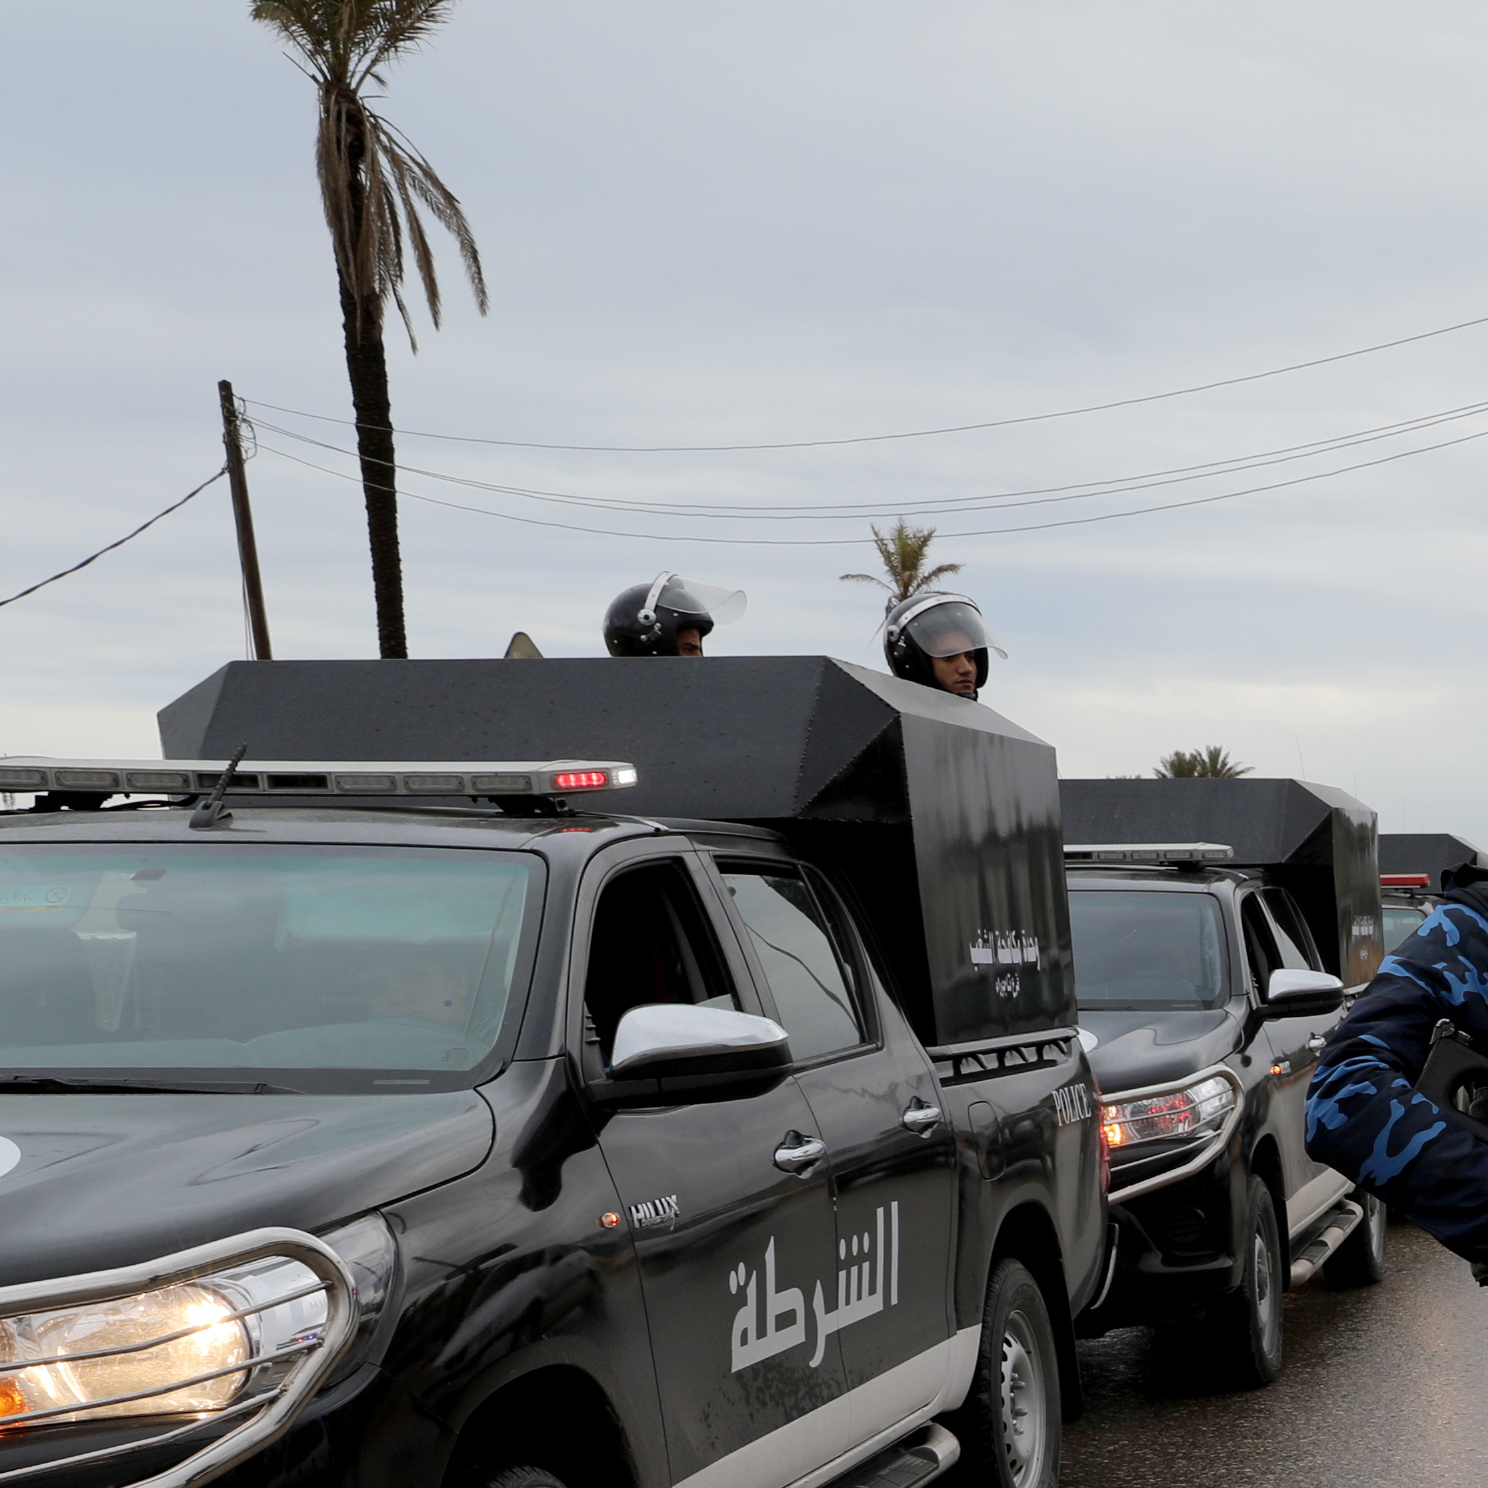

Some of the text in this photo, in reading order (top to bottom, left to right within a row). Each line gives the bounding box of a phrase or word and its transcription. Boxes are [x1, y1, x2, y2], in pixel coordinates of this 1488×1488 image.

[969, 929, 1041, 972] وحدة مكافحة الشغب
[1051, 1082, 1092, 1127] POLICE
[630, 1194, 680, 1228] HILUX
[729, 1200, 899, 1374] الشرطة
